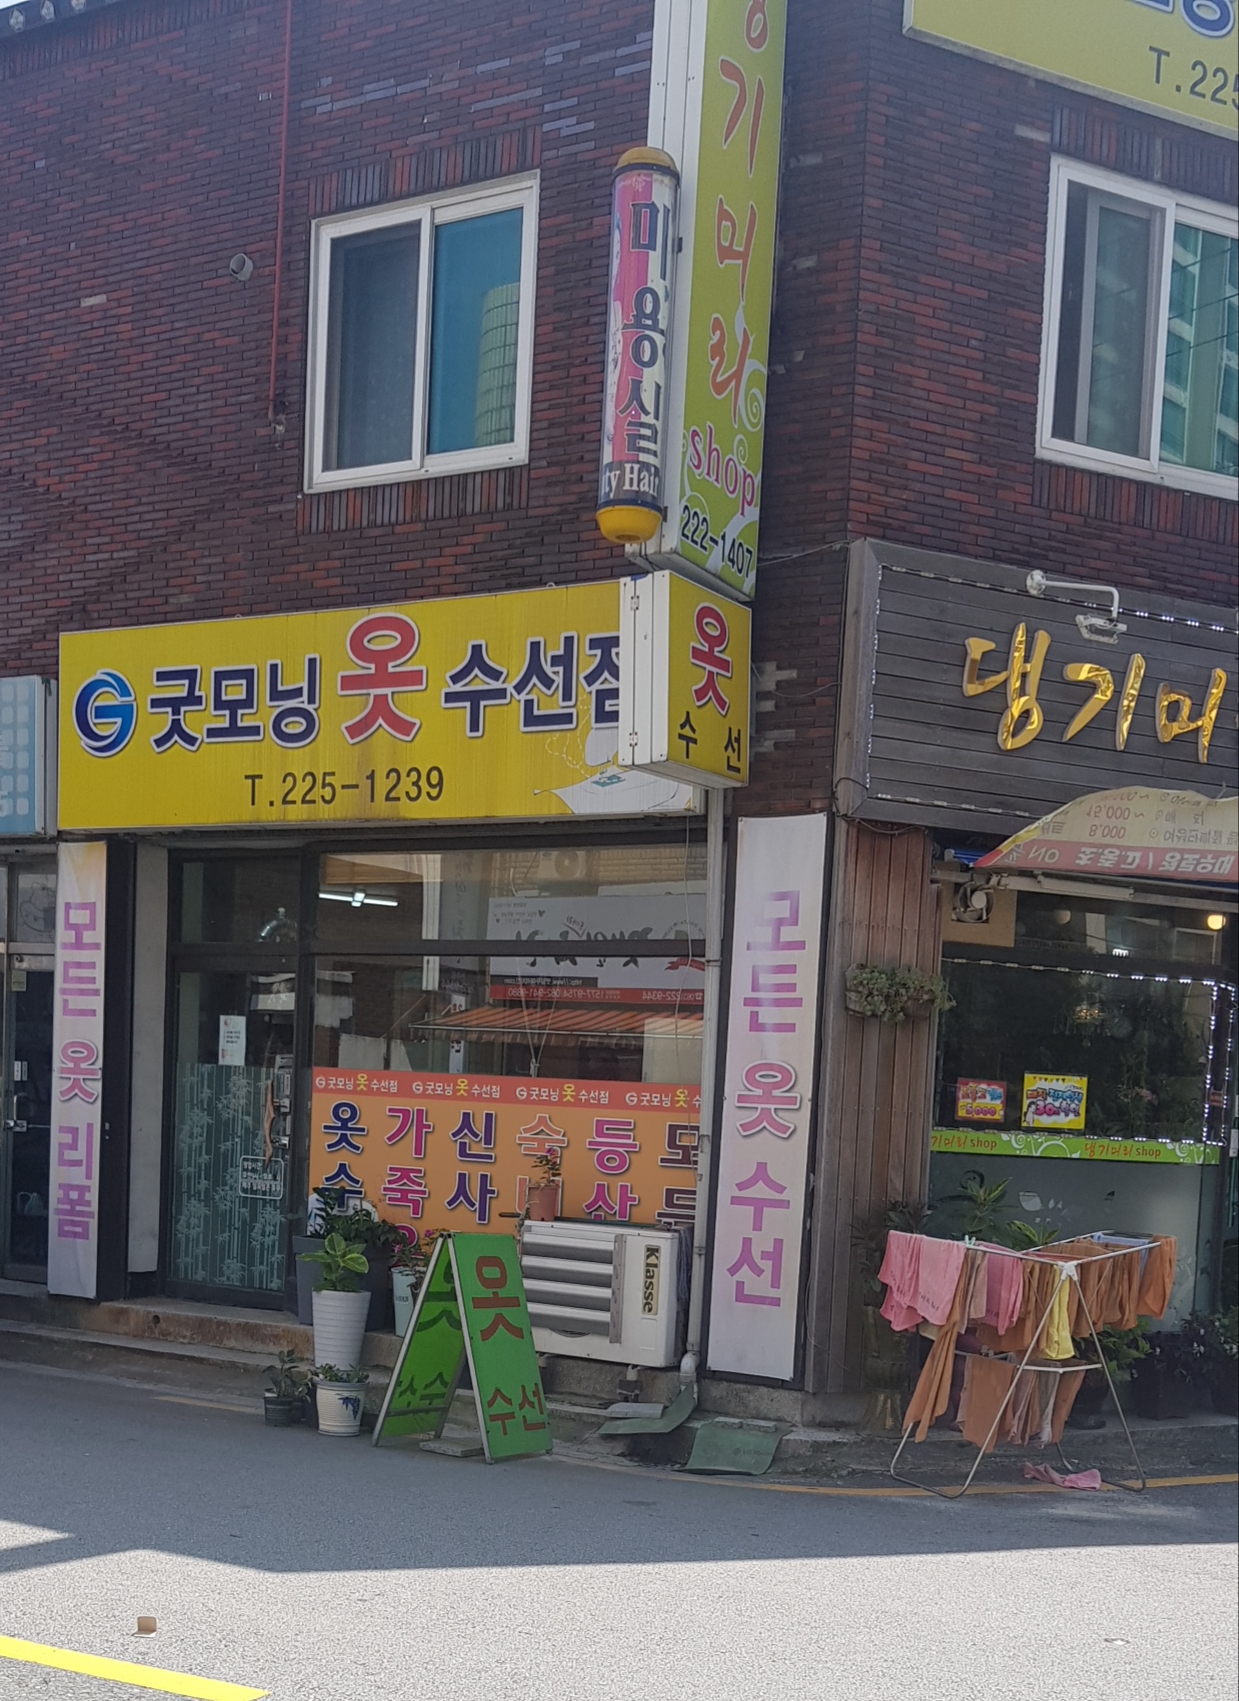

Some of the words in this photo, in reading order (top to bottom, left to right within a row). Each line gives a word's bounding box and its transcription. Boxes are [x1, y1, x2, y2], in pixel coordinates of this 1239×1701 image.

[618, 200, 670, 464] 미용실
[681, 504, 753, 578] 222-1407
[147, 653, 321, 752] 굿모닝
[337, 612, 427, 744] 옷
[690, 602, 732, 715] 옷
[59, 902, 101, 1018] 모든
[743, 889, 806, 1033] 모든
[58, 1039, 101, 1104] 옷
[328, 1077, 354, 1090] 굿모닝
[356, 1073, 368, 1091] 옷
[370, 1079, 398, 1093] 수선점
[425, 1082, 453, 1096] 굿모닝
[456, 1078, 469, 1096] 옷
[471, 1084, 500, 1098] 수선점
[529, 1087, 559, 1102] 굿모닝
[562, 1083, 576, 1102] 옷
[578, 1090, 609, 1104] 수선점
[640, 1093, 671, 1107] 굿모닝
[675, 1089, 688, 1108] 옷
[734, 1060, 801, 1138] 옷
[970, 1137, 997, 1152] shop
[1084, 1141, 1134, 1158] 댕기머리
[1136, 1144, 1161, 1159] shop
[54, 1123, 95, 1241] 리폼
[726, 1161, 791, 1307] 수선
[472, 1256, 524, 1342] 옷
[644, 1246, 660, 1314] Klasse
[487, 1383, 547, 1435] 수선
